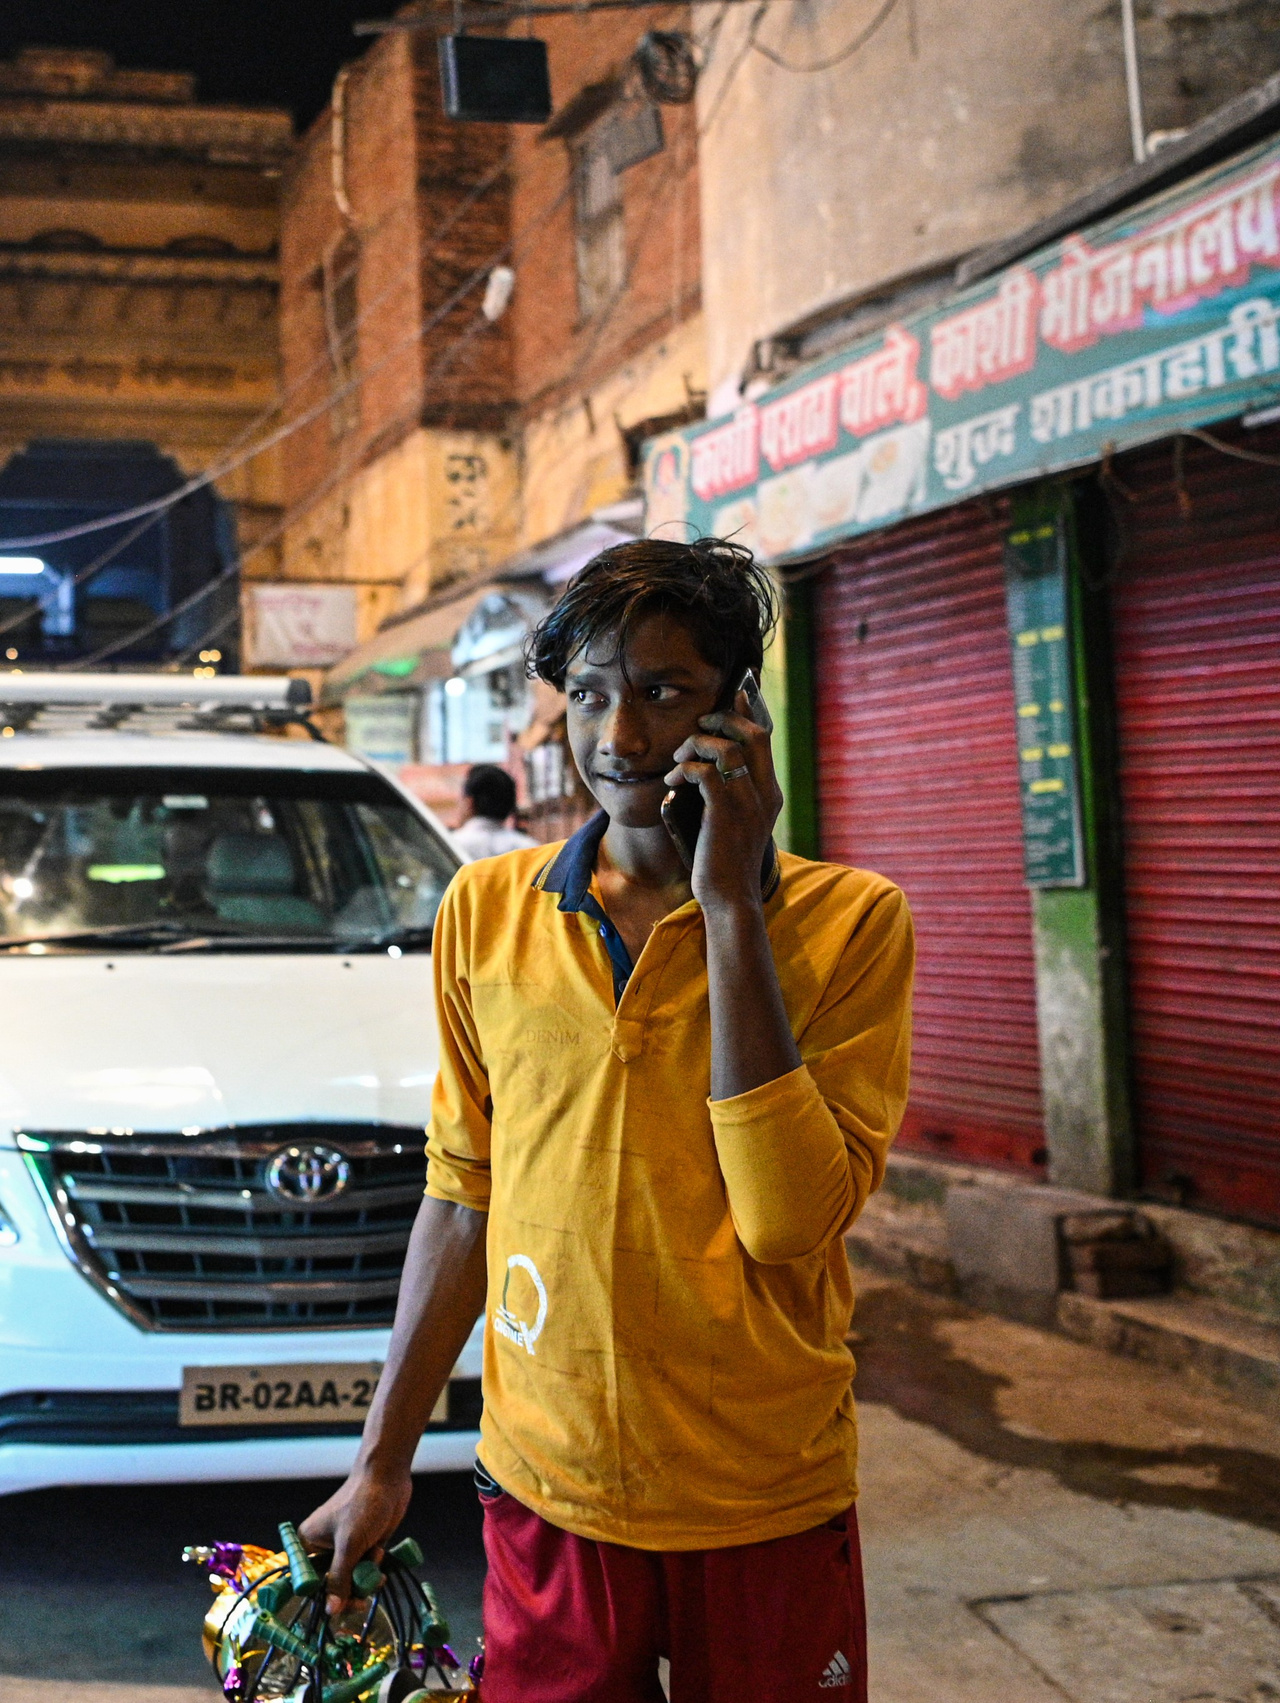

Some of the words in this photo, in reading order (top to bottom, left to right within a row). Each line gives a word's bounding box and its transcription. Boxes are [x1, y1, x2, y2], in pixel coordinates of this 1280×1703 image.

[931, 266, 1037, 400] काशी
[526, 1028, 581, 1045] DENIM
[195, 1380, 379, 1412] BR-02AA-2
